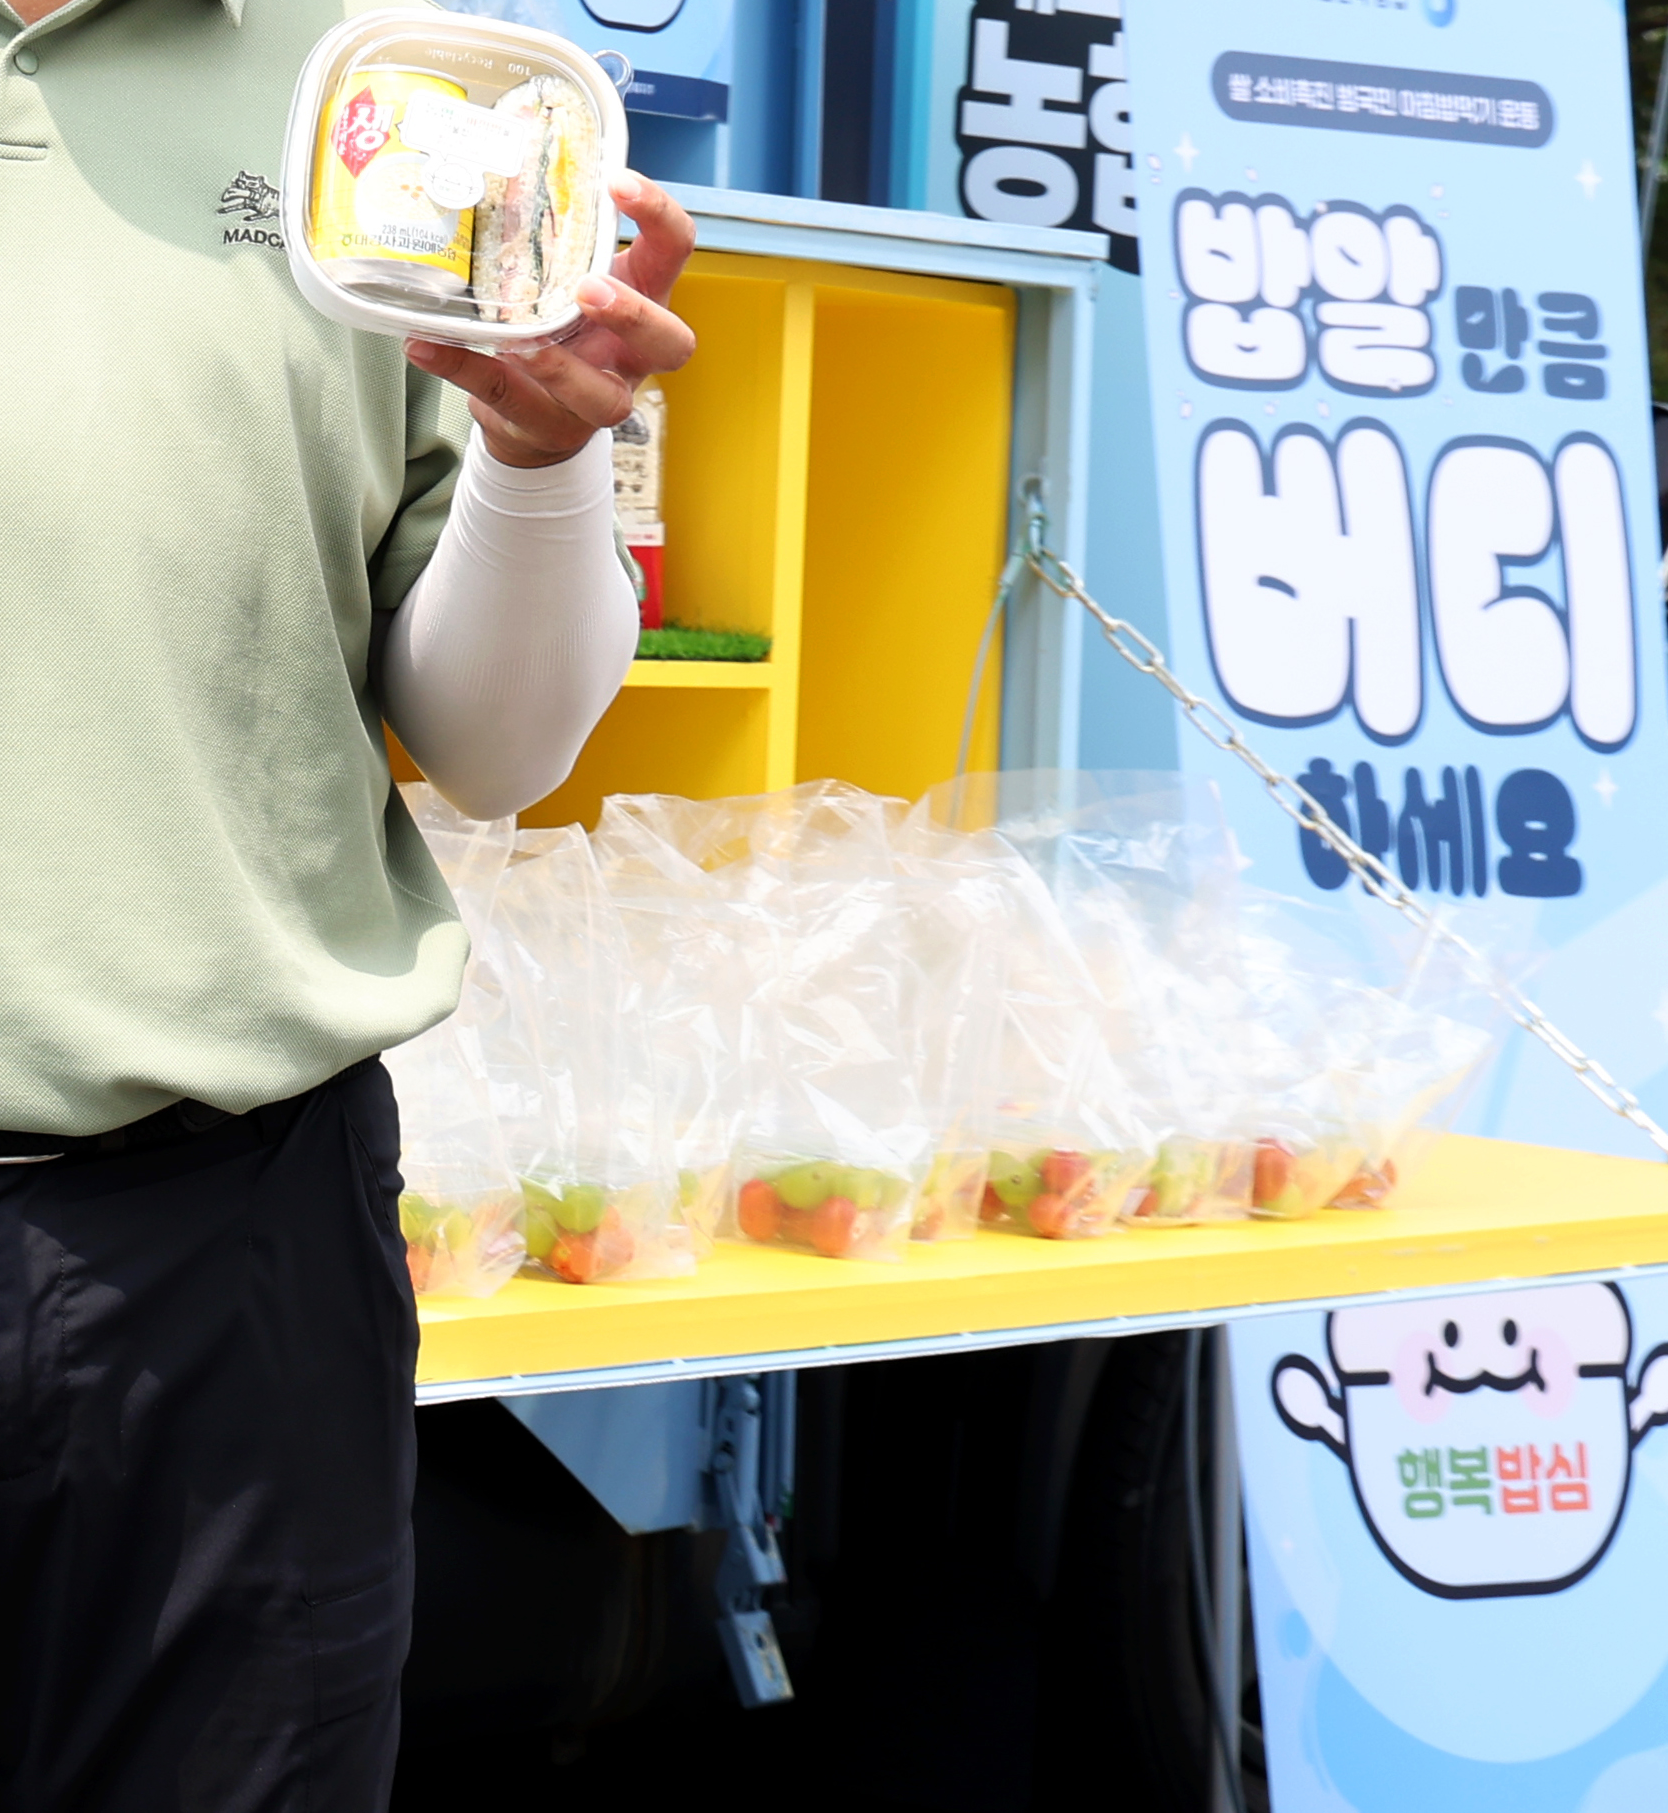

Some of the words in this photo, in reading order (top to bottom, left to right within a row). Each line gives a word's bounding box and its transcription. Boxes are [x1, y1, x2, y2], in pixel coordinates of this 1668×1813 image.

[223, 228, 285, 249] MADC
[1172, 187, 1442, 397] 밥알
[1455, 285, 1609, 400] 만큼
[1196, 417, 1638, 755] 버디
[1295, 757, 1584, 899] 하세요
[1398, 1442, 1591, 1519] 행복밥심
